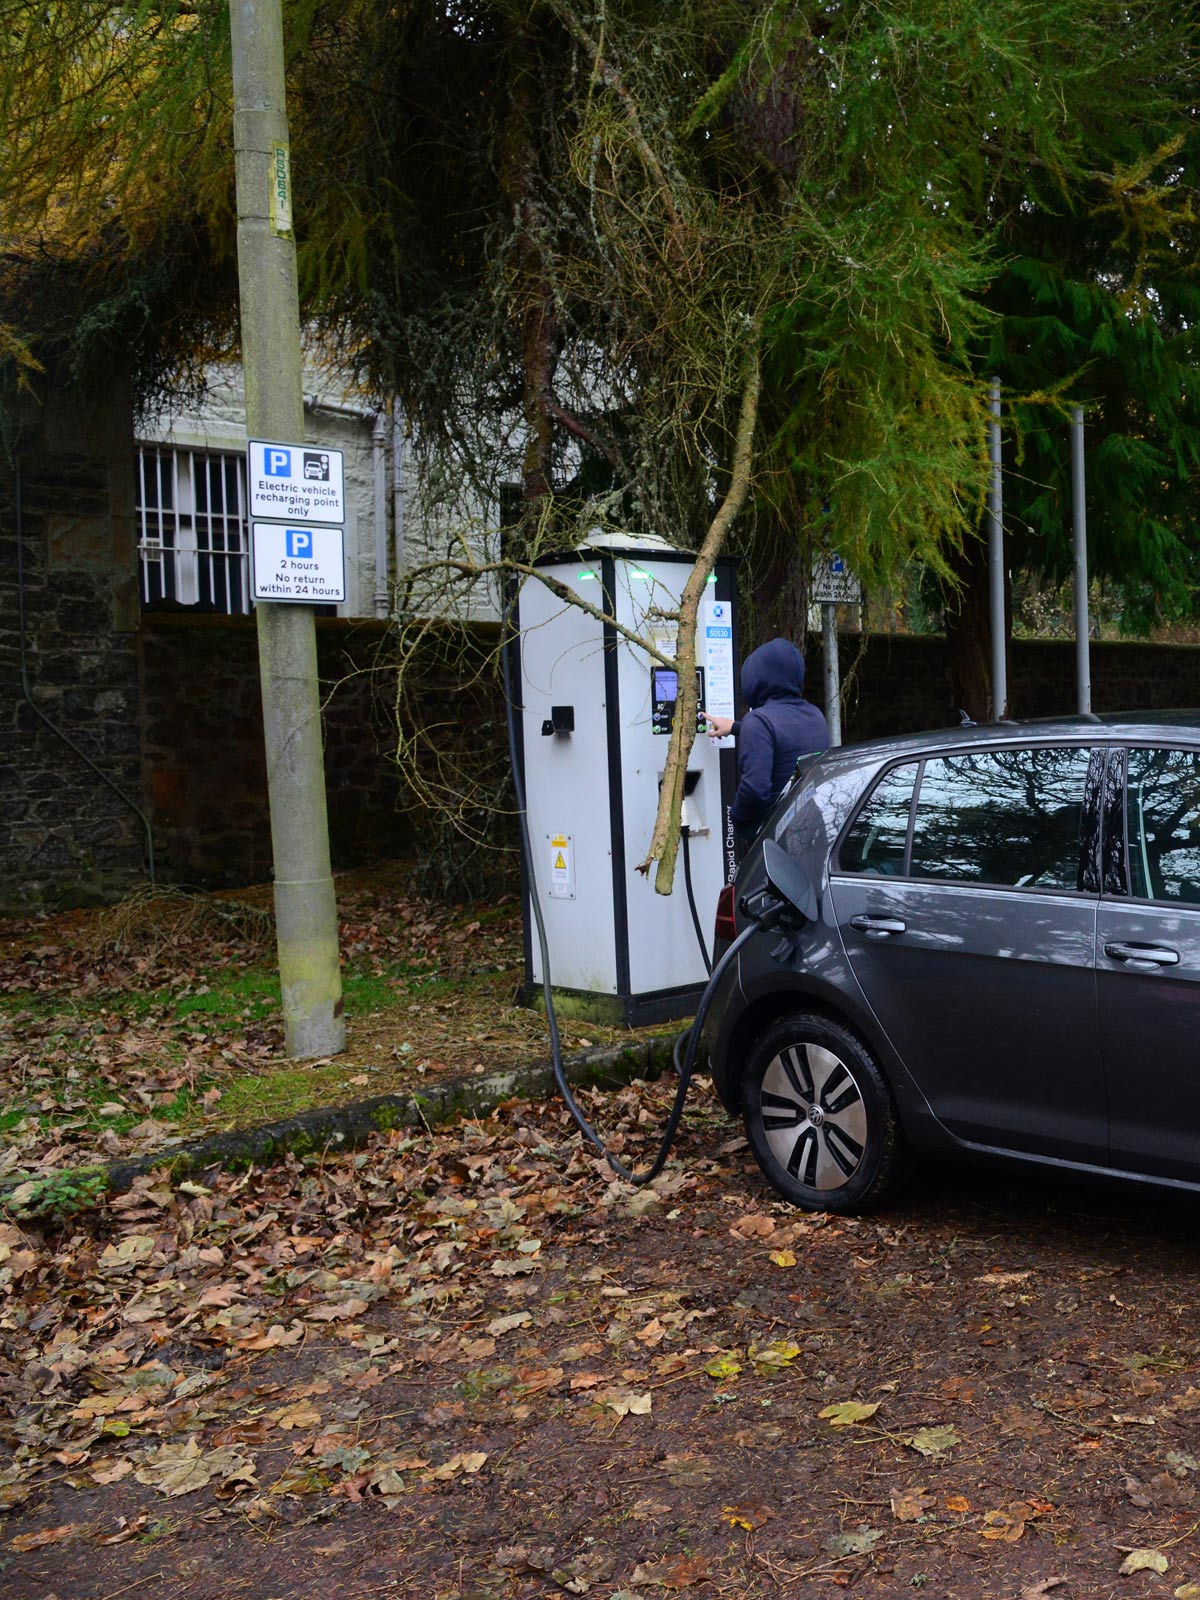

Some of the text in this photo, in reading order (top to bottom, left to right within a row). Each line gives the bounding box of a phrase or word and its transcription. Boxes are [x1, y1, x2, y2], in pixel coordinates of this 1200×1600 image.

[270, 450, 288, 474] P
[258, 480, 337, 497] Electric vehicle
[255, 492, 340, 508] recharging point
[287, 506, 309, 517] only
[291, 532, 310, 556] P
[280, 559, 319, 570] 2 hours
[275, 573, 325, 584] No return
[259, 584, 340, 596] within 24 hours
[709, 629, 729, 637] 50530
